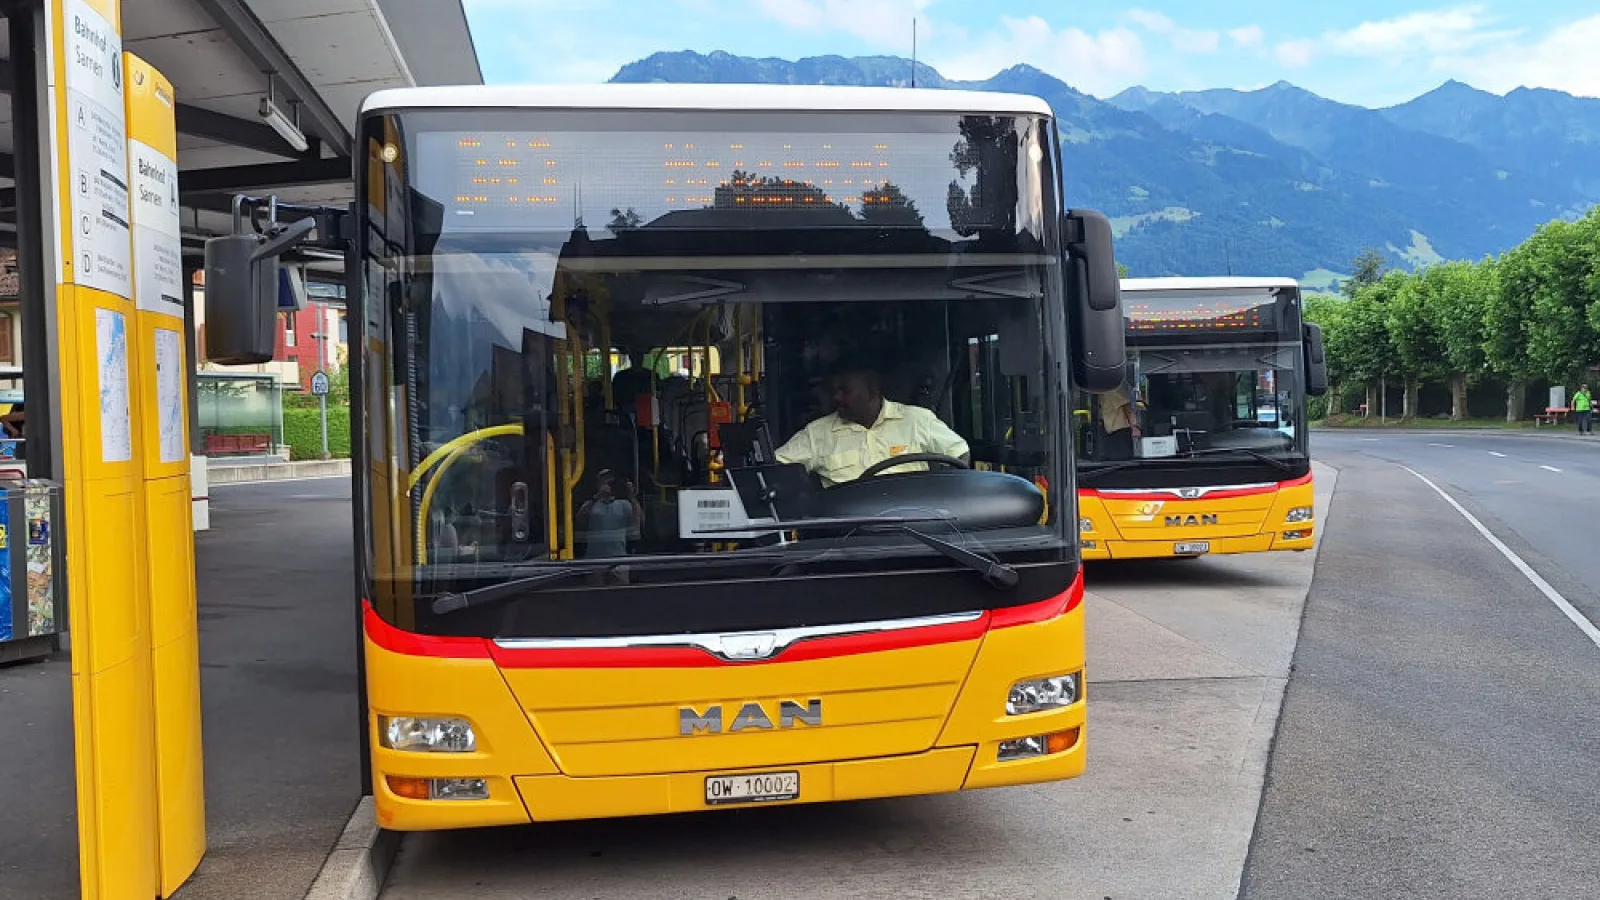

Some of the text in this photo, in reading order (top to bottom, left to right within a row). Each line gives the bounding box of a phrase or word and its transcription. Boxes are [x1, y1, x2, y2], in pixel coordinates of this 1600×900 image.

[74, 15, 107, 54] Bahnhof
[75, 44, 103, 79] Sarnen
[78, 106, 86, 126] A
[138, 158, 166, 184] Bahnhof
[80, 174, 87, 194] B
[139, 183, 163, 207] Sarnen
[82, 215, 89, 235] C
[83, 253, 90, 273] D
[1165, 513, 1217, 526] MAN
[679, 697, 822, 735] MAN
[711, 775, 794, 797] OW 10002
